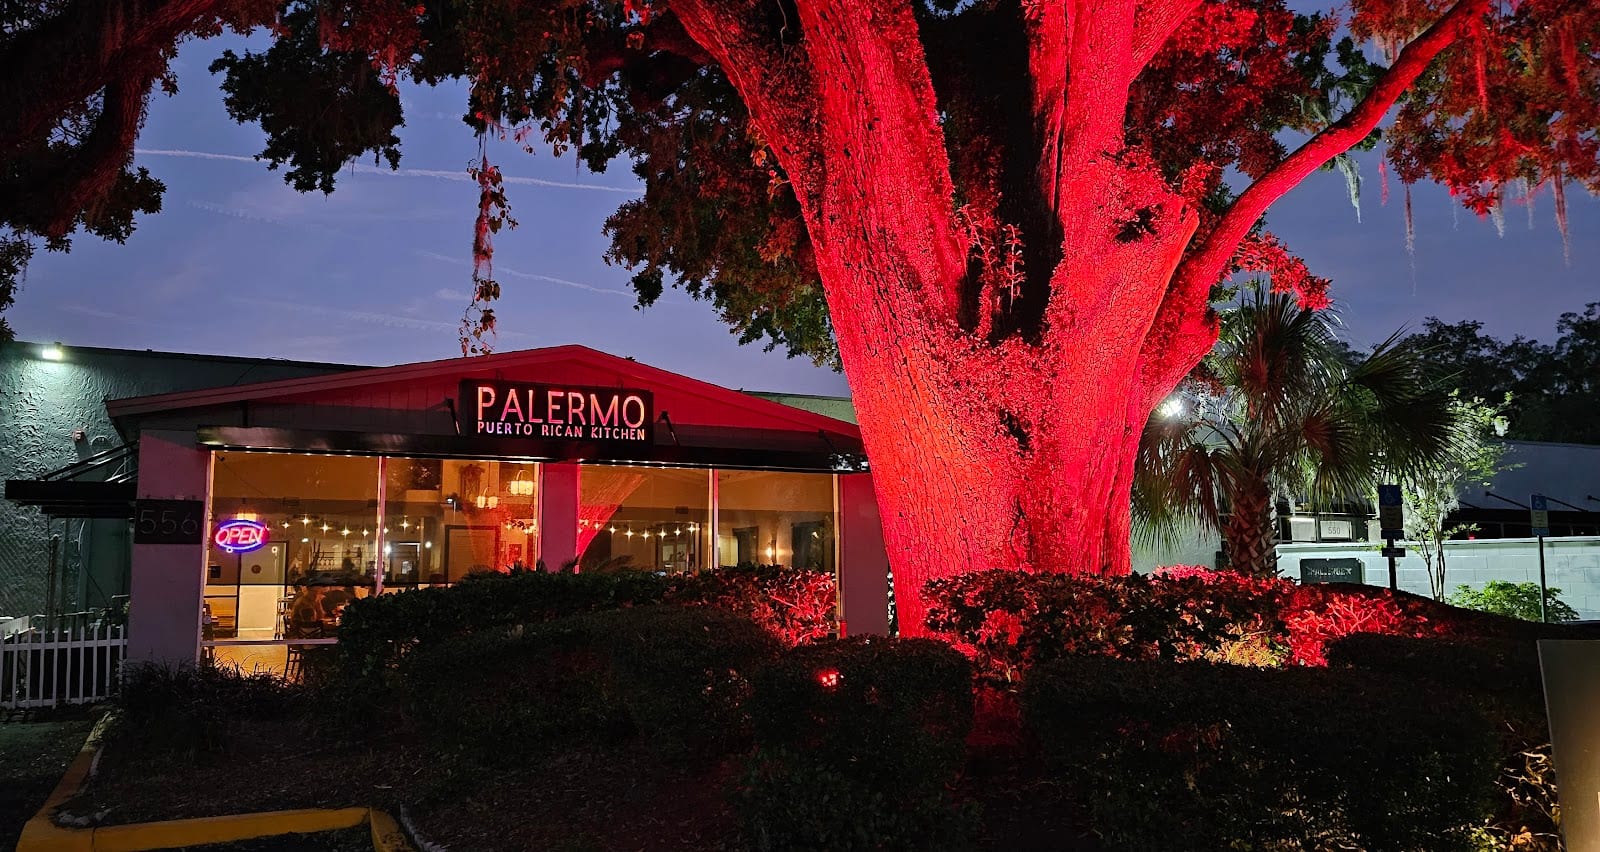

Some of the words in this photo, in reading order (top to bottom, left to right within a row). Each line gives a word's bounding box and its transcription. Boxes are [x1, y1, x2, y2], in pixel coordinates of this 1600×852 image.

[477, 386, 645, 428] PALERMO
[477, 421, 533, 436] PUERTO
[541, 424, 583, 438] RICAN
[591, 426, 646, 441] KITCHEN
[139, 509, 199, 535] 556
[215, 528, 264, 545] OPEN
